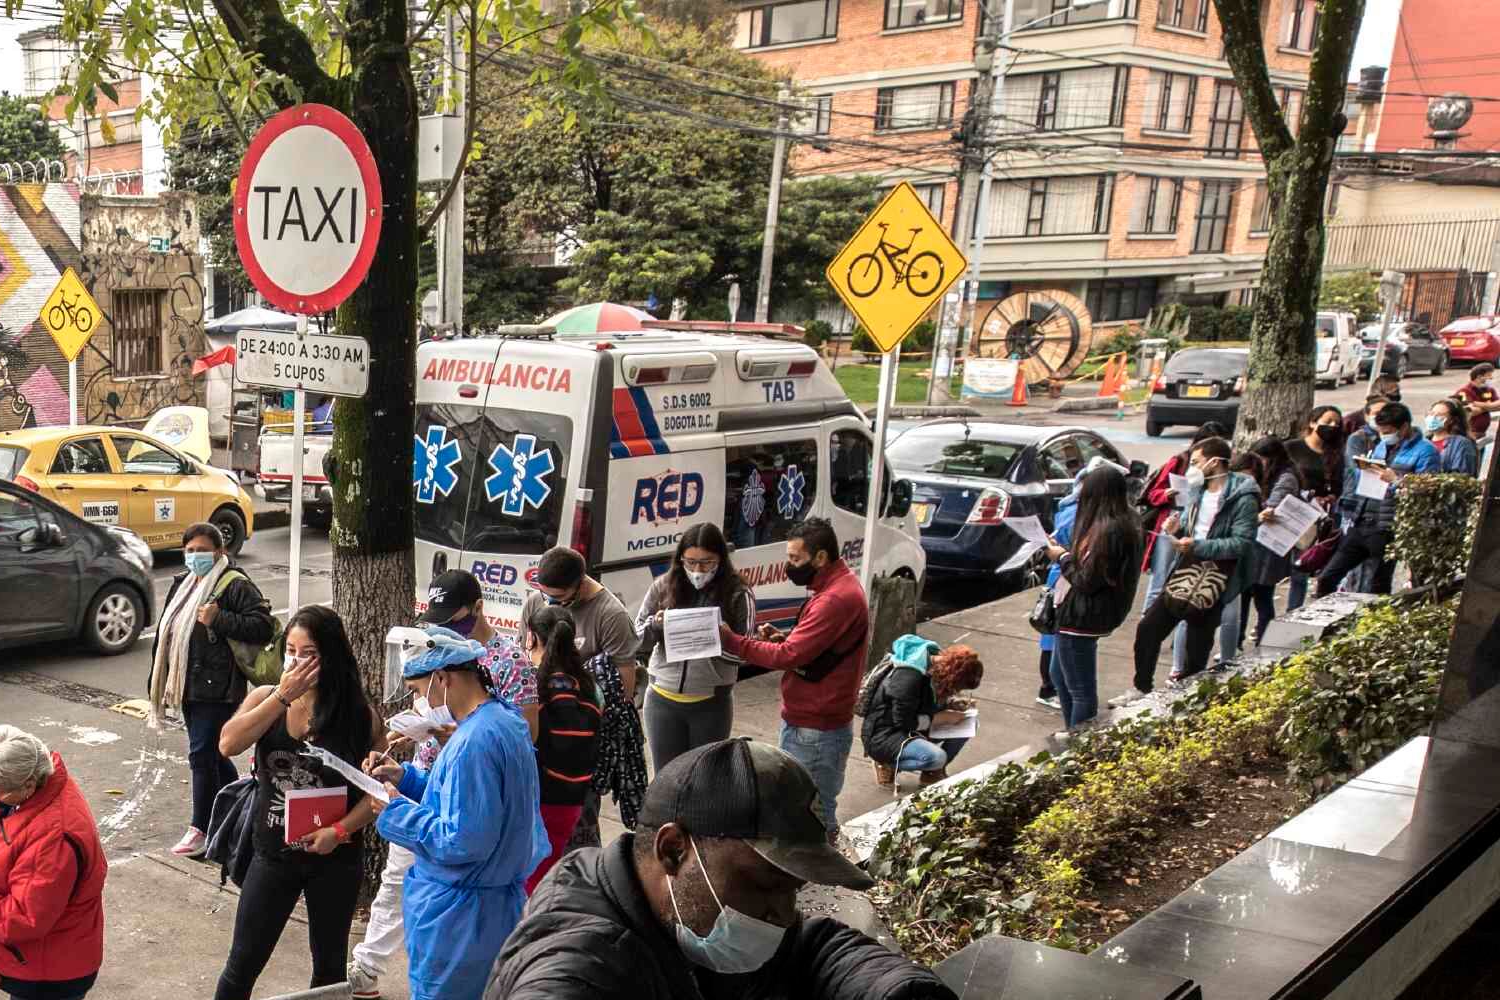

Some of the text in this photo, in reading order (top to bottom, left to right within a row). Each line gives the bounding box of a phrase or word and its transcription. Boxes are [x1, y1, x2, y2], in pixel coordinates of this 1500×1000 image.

[253, 186, 358, 244] TAXI
[240, 338, 364, 363] DE 24:00 A 3:30 AM
[273, 363, 326, 382] 5 CUPOS
[423, 358, 572, 393] AMBULANCIA
[689, 392, 712, 408] 6002
[761, 380, 796, 403] TAB
[664, 415, 697, 431] BOGOTA
[630, 471, 705, 525] RED
[471, 560, 518, 587] RED
